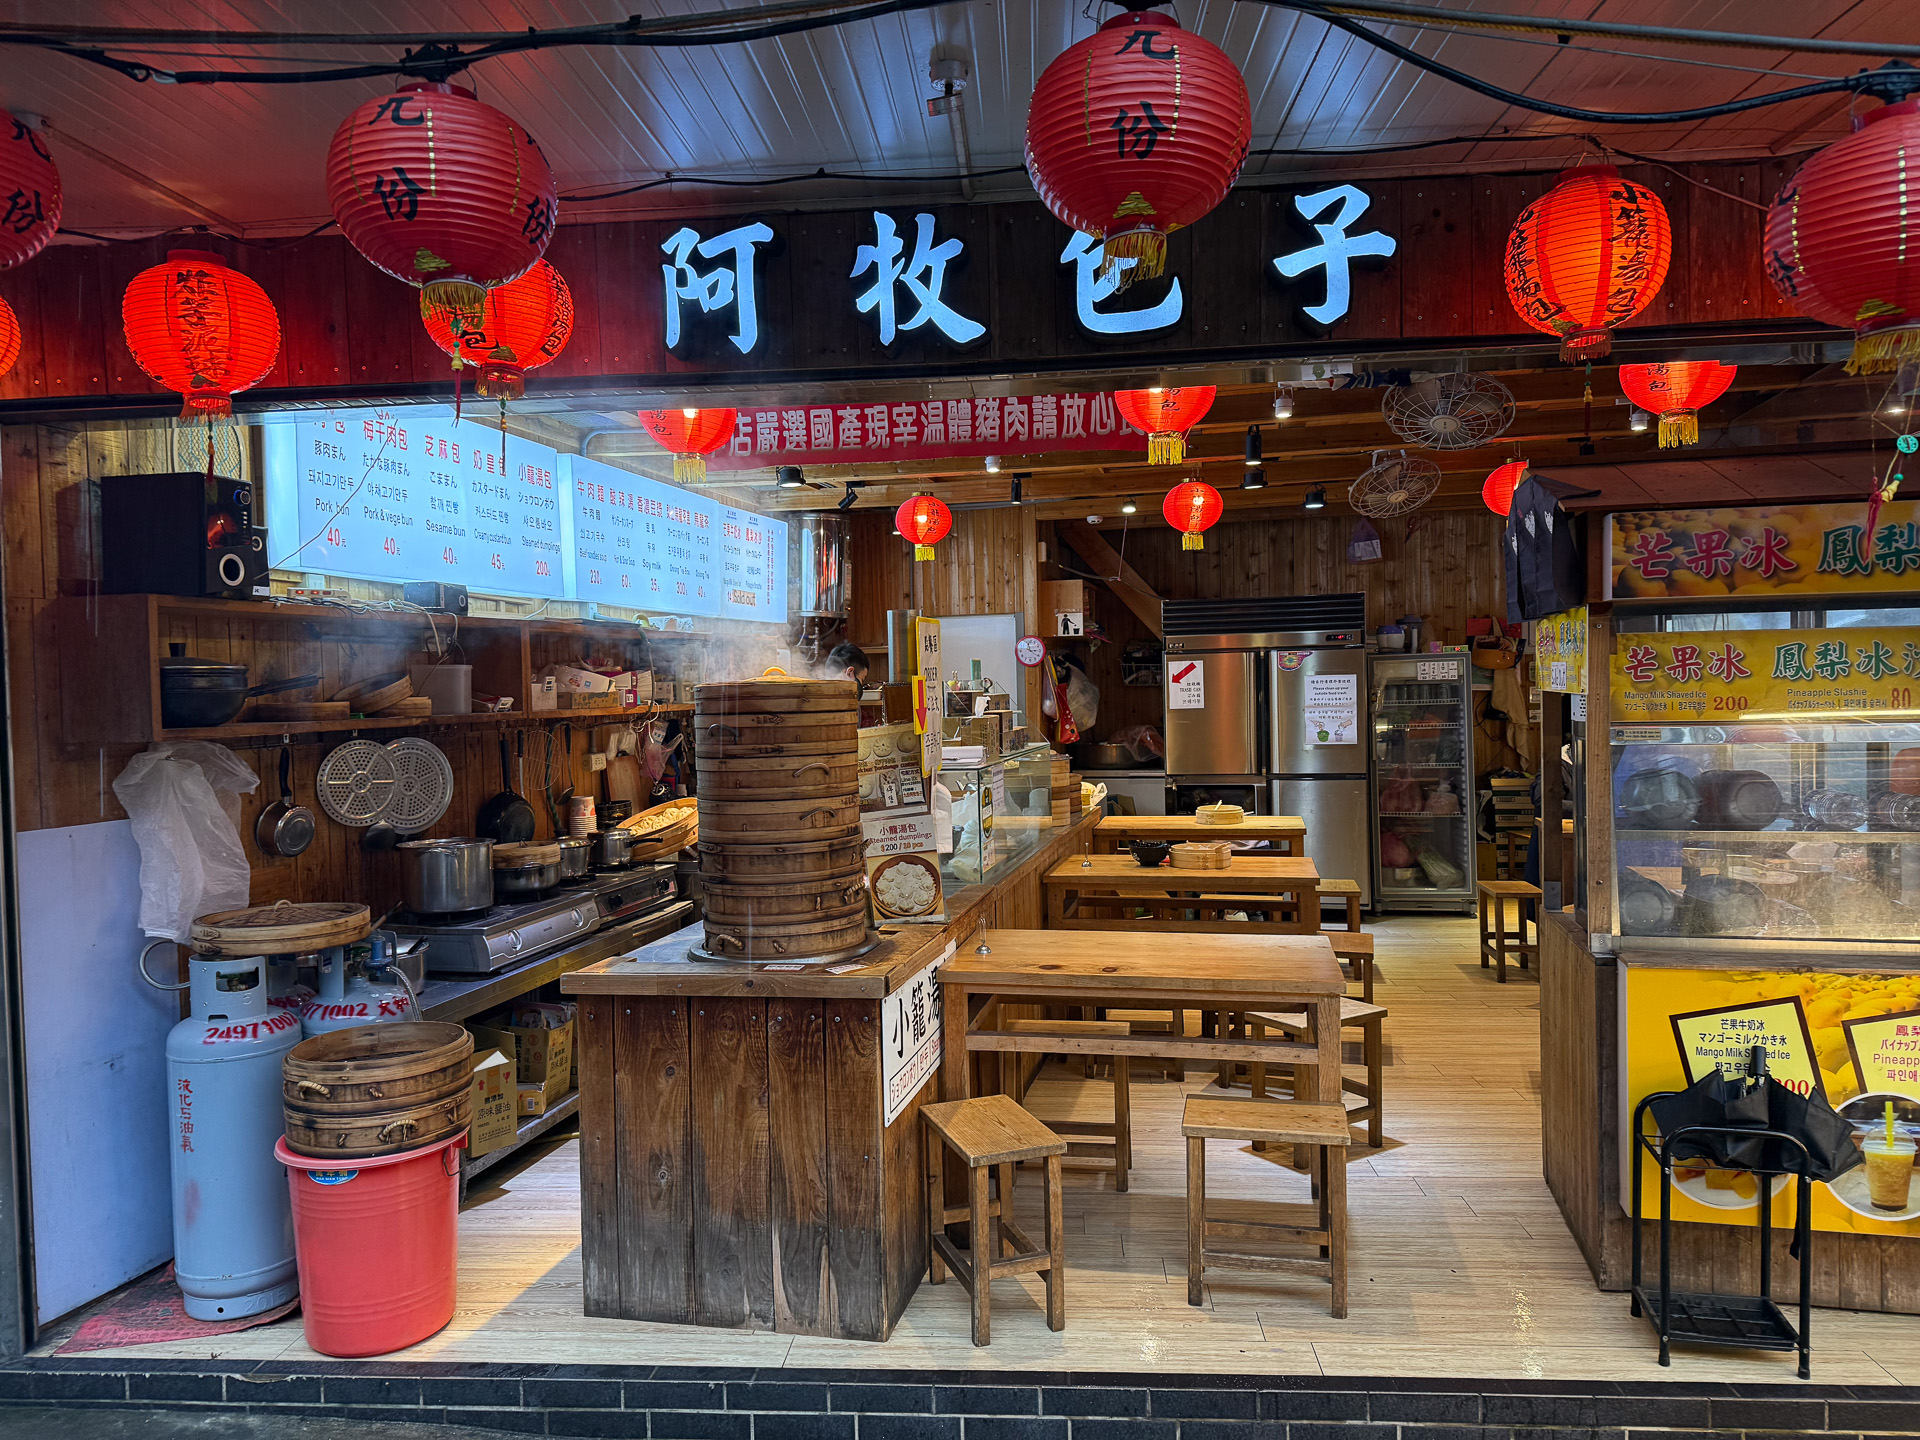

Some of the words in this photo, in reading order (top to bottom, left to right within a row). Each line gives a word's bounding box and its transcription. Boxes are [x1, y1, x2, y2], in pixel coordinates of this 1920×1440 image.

[1110, 30, 1175, 159] 九份
[369, 96, 426, 221] 九份
[661, 184, 1397, 355] 阿牧包子
[711, 391, 1146, 458] 店嚴選國產現宰温體豬肉請放心
[314, 439, 346, 461] 豚肉まん
[424, 434, 460, 464] 芝麻包
[315, 497, 333, 513] Pork
[336, 501, 350, 516] bun
[363, 506, 380, 521] Pork
[425, 519, 452, 534] Sesame
[453, 524, 466, 537] bun
[1630, 526, 1797, 580] 芒果冰
[1817, 522, 1920, 576] 鳳梨
[1624, 643, 1752, 684] 芒果冰
[1624, 691, 1649, 701] Mango
[1650, 690, 1665, 699] Milk
[1666, 690, 1694, 699] Shaved
[1695, 690, 1707, 699] Ice
[1787, 688, 1832, 698] Pineapple
[1834, 687, 1868, 697] Slushie
[1891, 687, 1912, 710] 80
[1713, 696, 1749, 711] 200
[898, 831, 933, 842] dumplings
[1720, 1018, 1765, 1031] 芒果牛奶冰
[1698, 1032, 1787, 1046] マンゴーミルクかき氷
[1695, 1046, 1724, 1059] Mango
[1725, 1047, 1743, 1058] Milk
[1744, 1048, 1775, 1059] Sed
[1777, 1050, 1791, 1060] Ice
[1887, 1069, 1920, 1082] 파인애
[1774, 1078, 1809, 1096] 00
